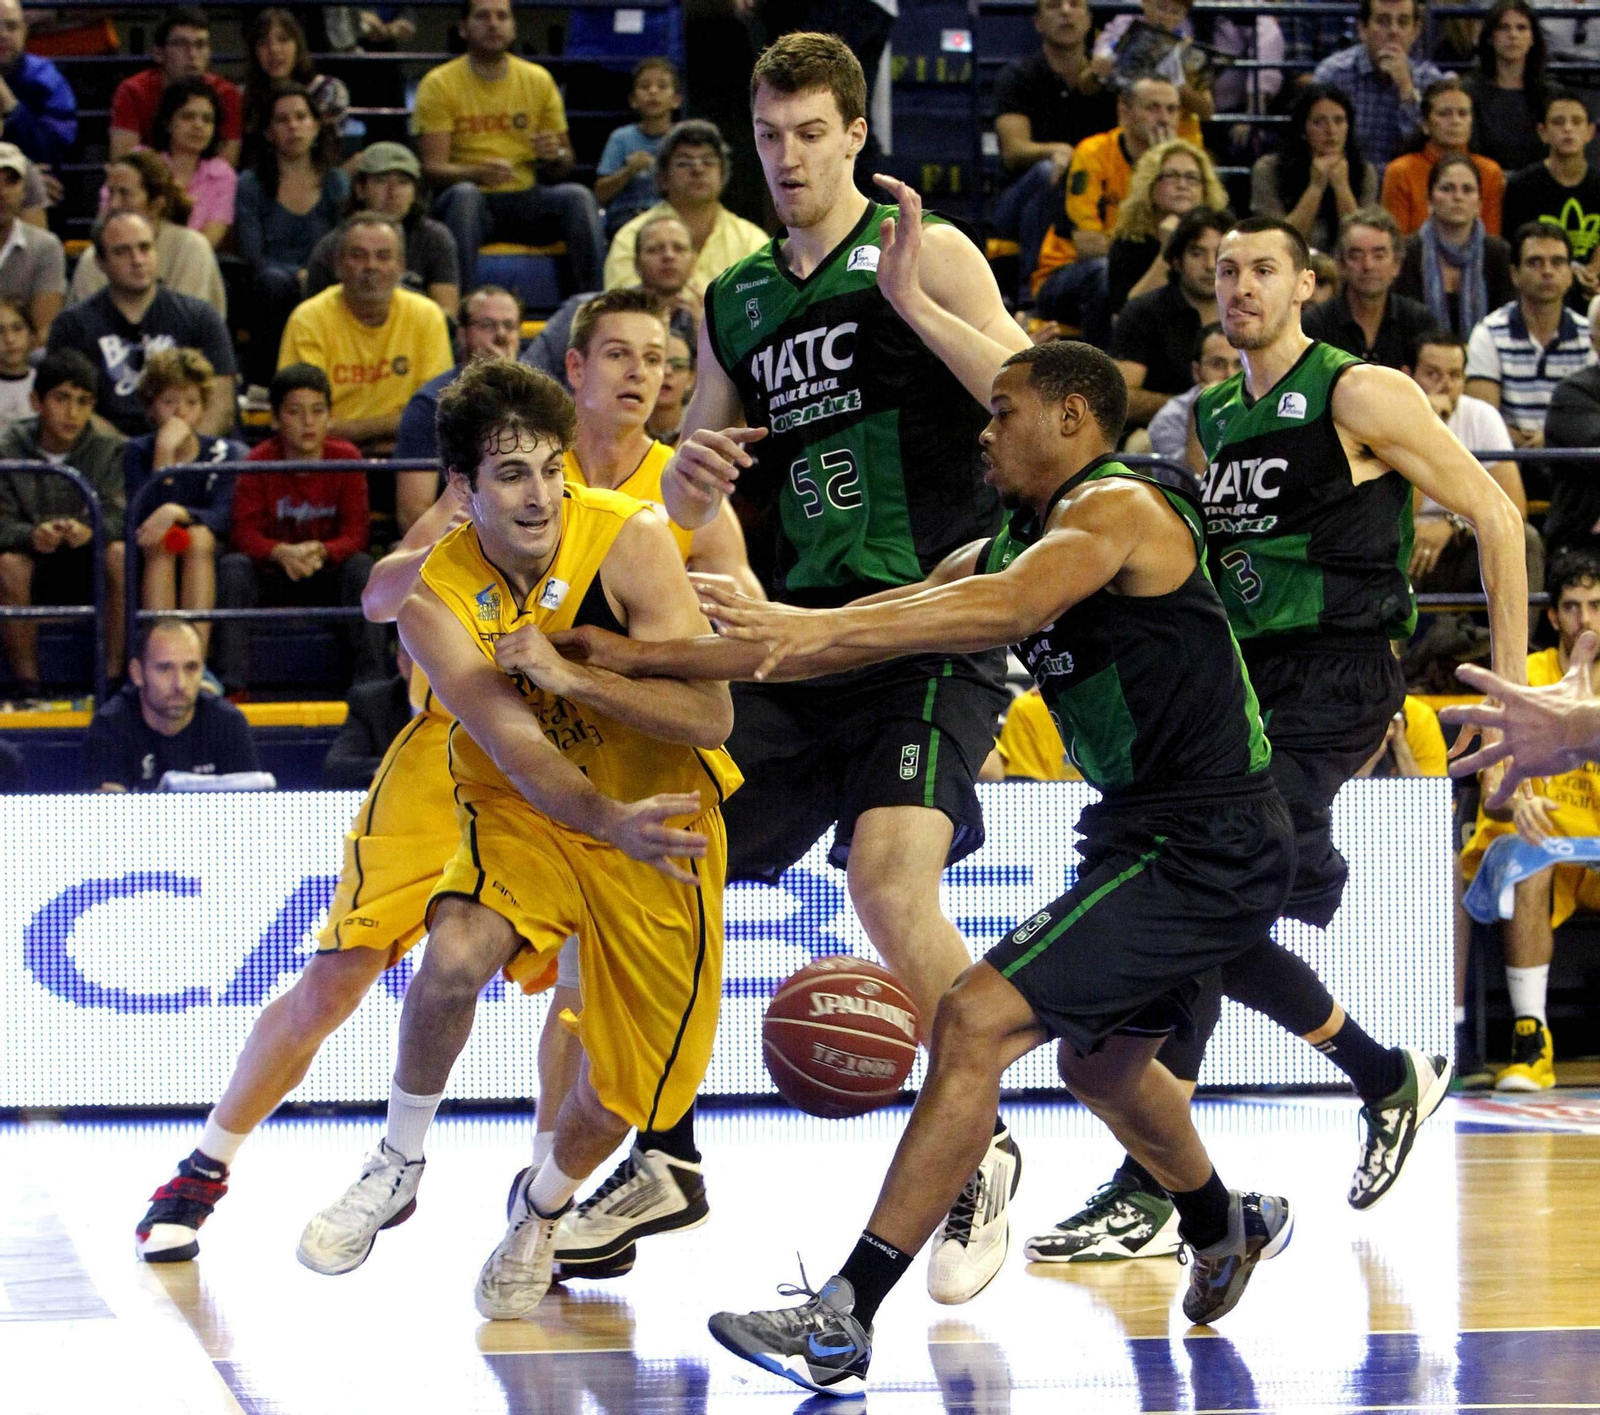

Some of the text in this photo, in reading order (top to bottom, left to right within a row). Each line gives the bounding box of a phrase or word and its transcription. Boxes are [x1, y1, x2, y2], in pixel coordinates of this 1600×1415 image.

[769, 388, 863, 438] oventut
[790, 448, 864, 519] 52
[808, 991, 917, 1041] SPALDING
